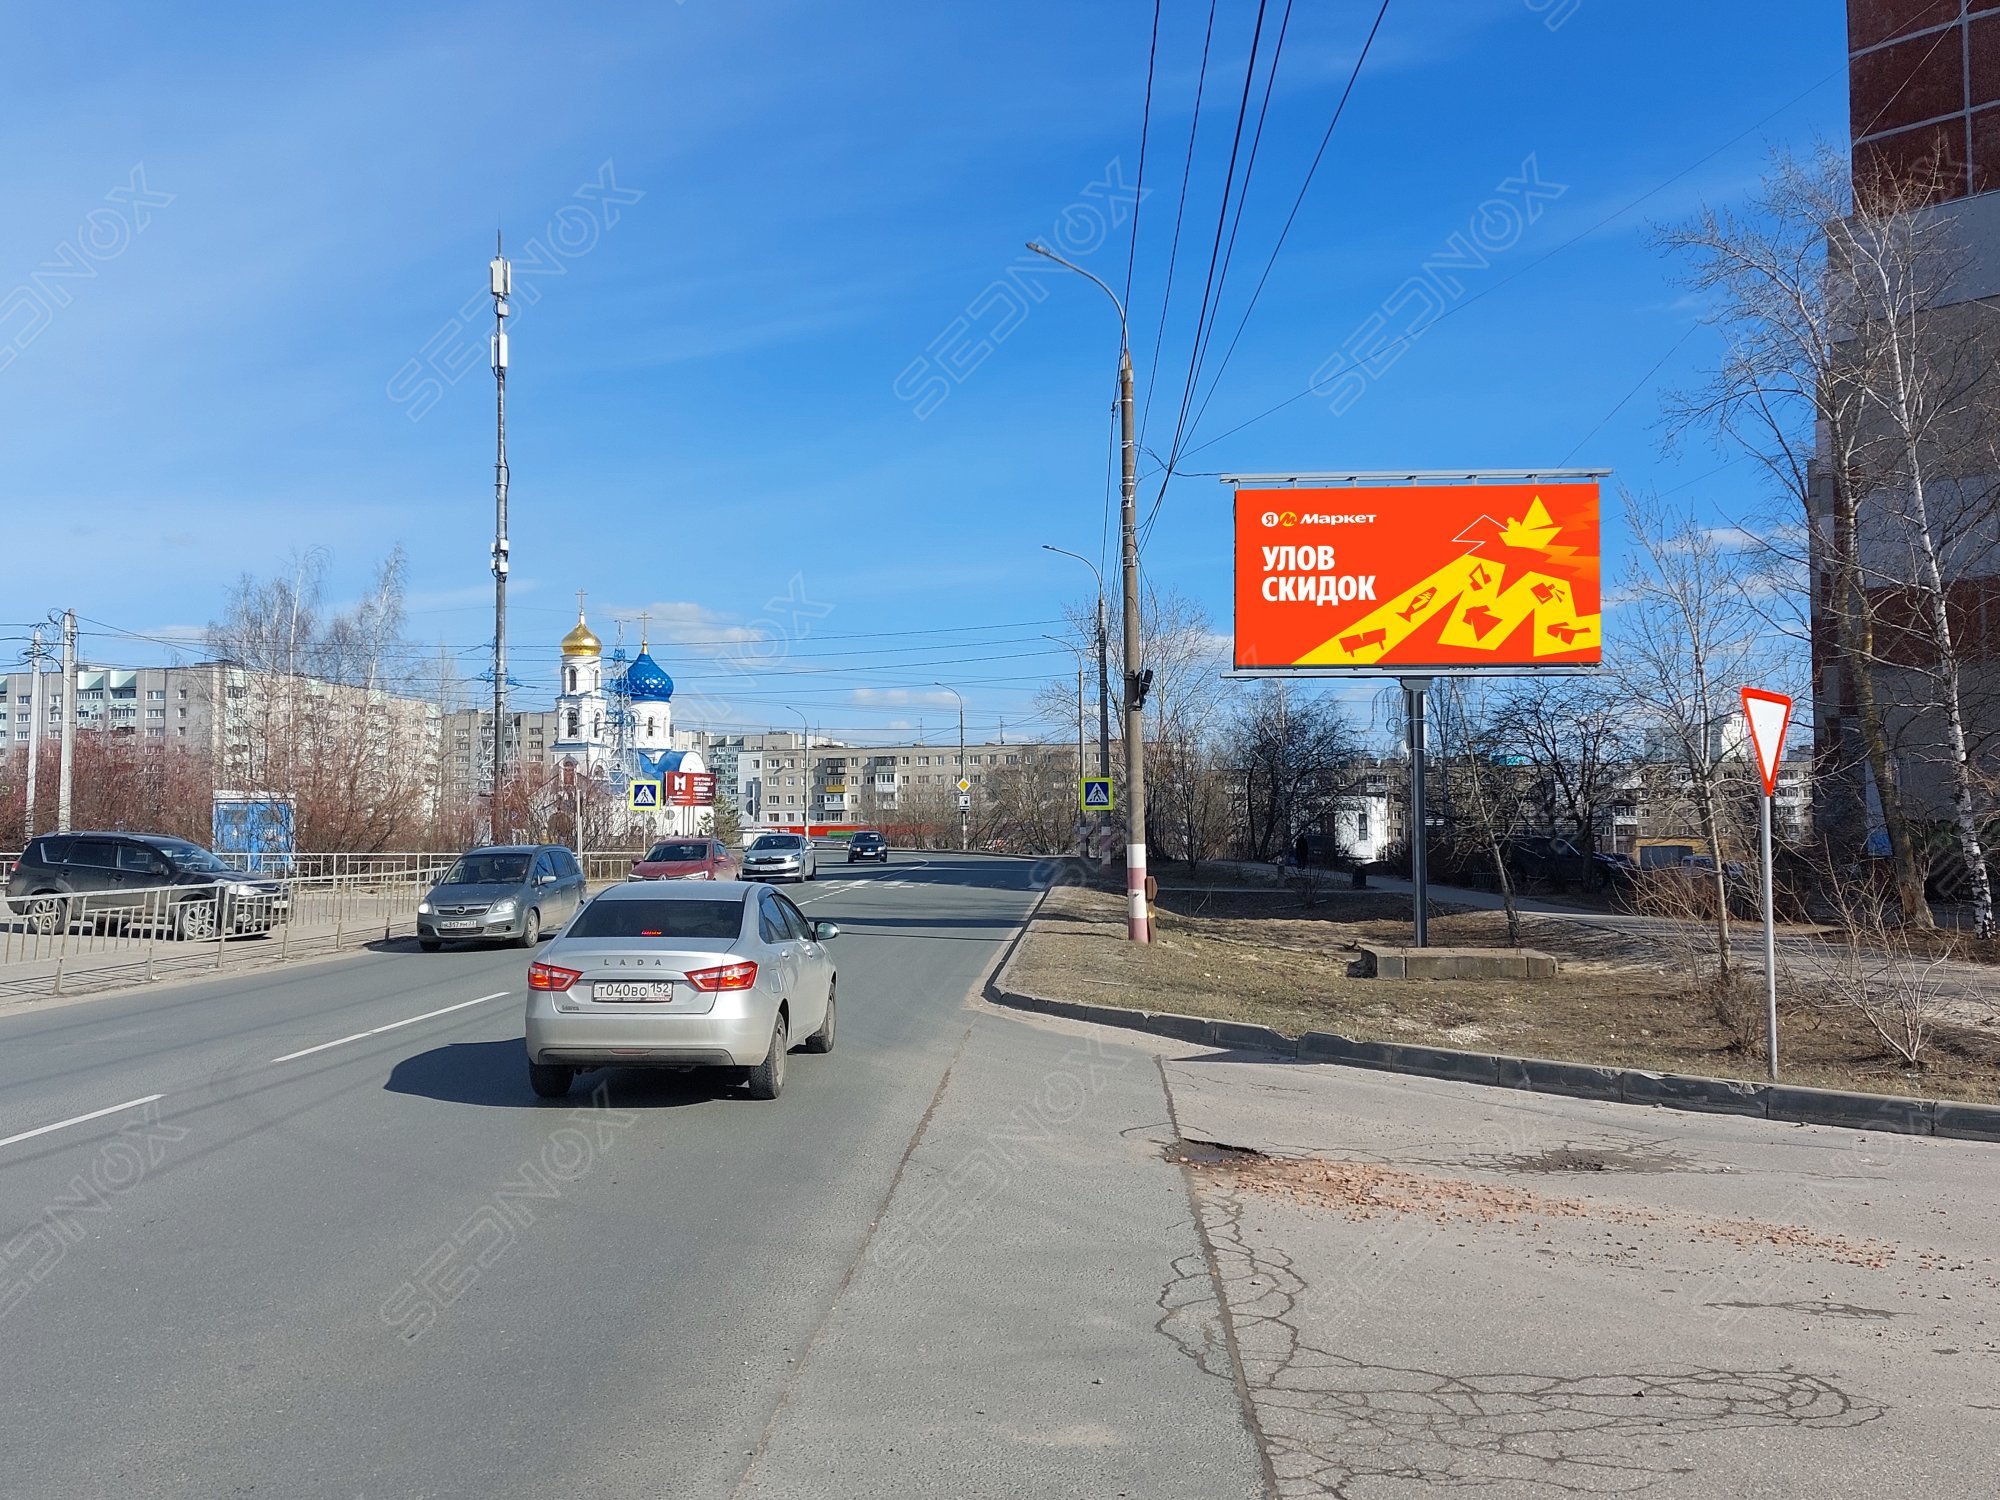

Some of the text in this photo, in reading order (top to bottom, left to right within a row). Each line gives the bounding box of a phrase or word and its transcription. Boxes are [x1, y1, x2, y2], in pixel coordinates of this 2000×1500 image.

[1300, 513, 1377, 525] Маркет
[1261, 545, 1336, 571] УЛОВ
[1261, 575, 1377, 606] СКИДОК
[650, 982, 669, 993] 152
